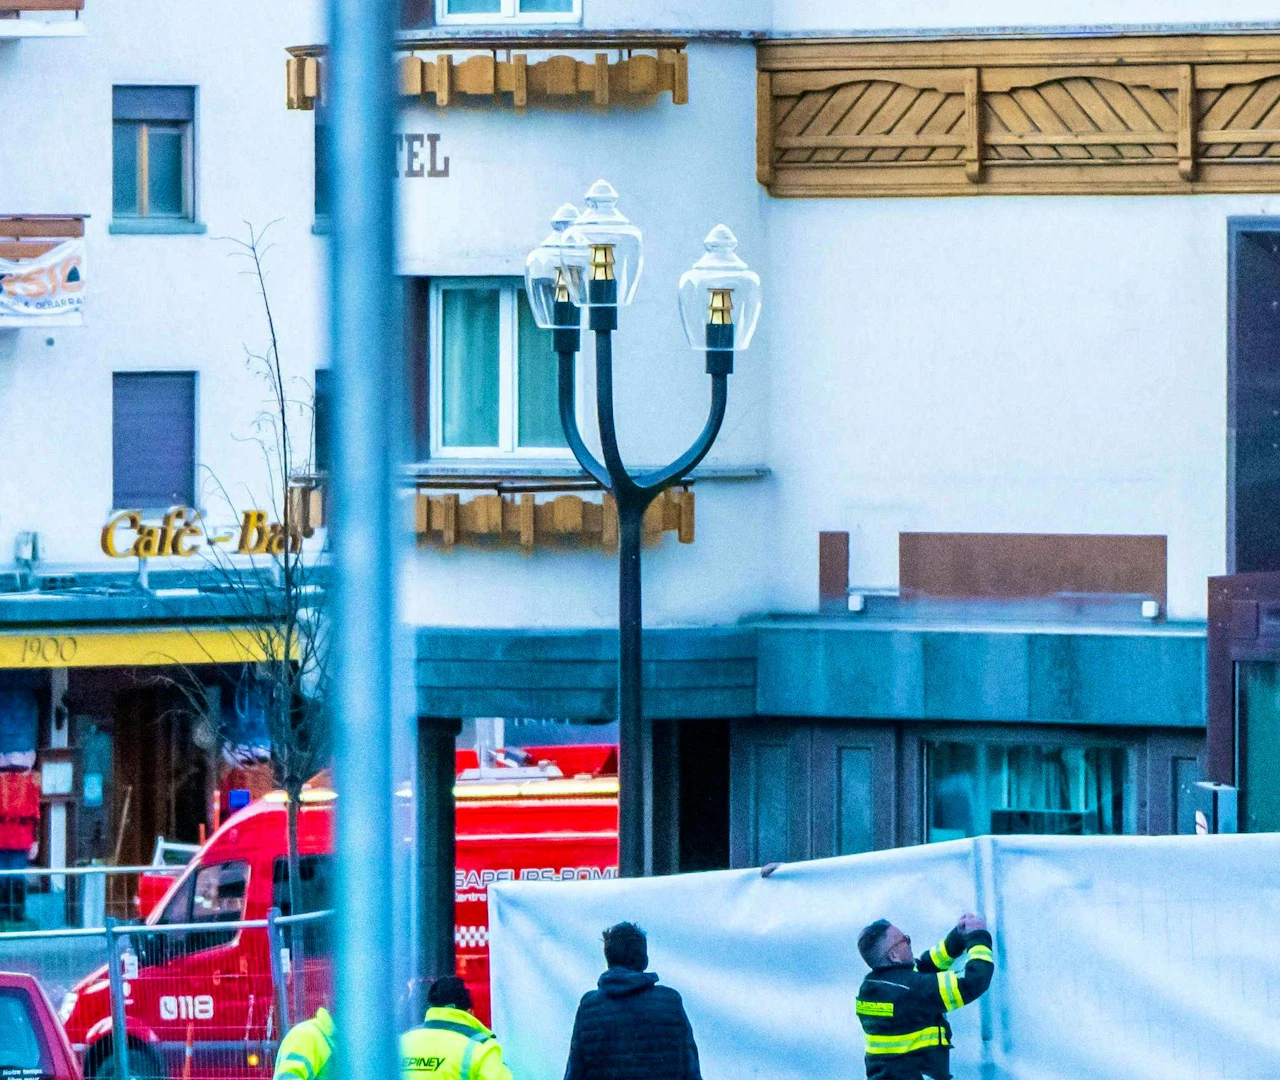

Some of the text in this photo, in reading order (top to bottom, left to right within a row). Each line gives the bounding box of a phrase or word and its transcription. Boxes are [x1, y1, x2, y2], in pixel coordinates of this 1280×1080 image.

[101, 504, 203, 558] Café
[21, 636, 78, 663] 1900
[178, 995, 214, 1019] 118
